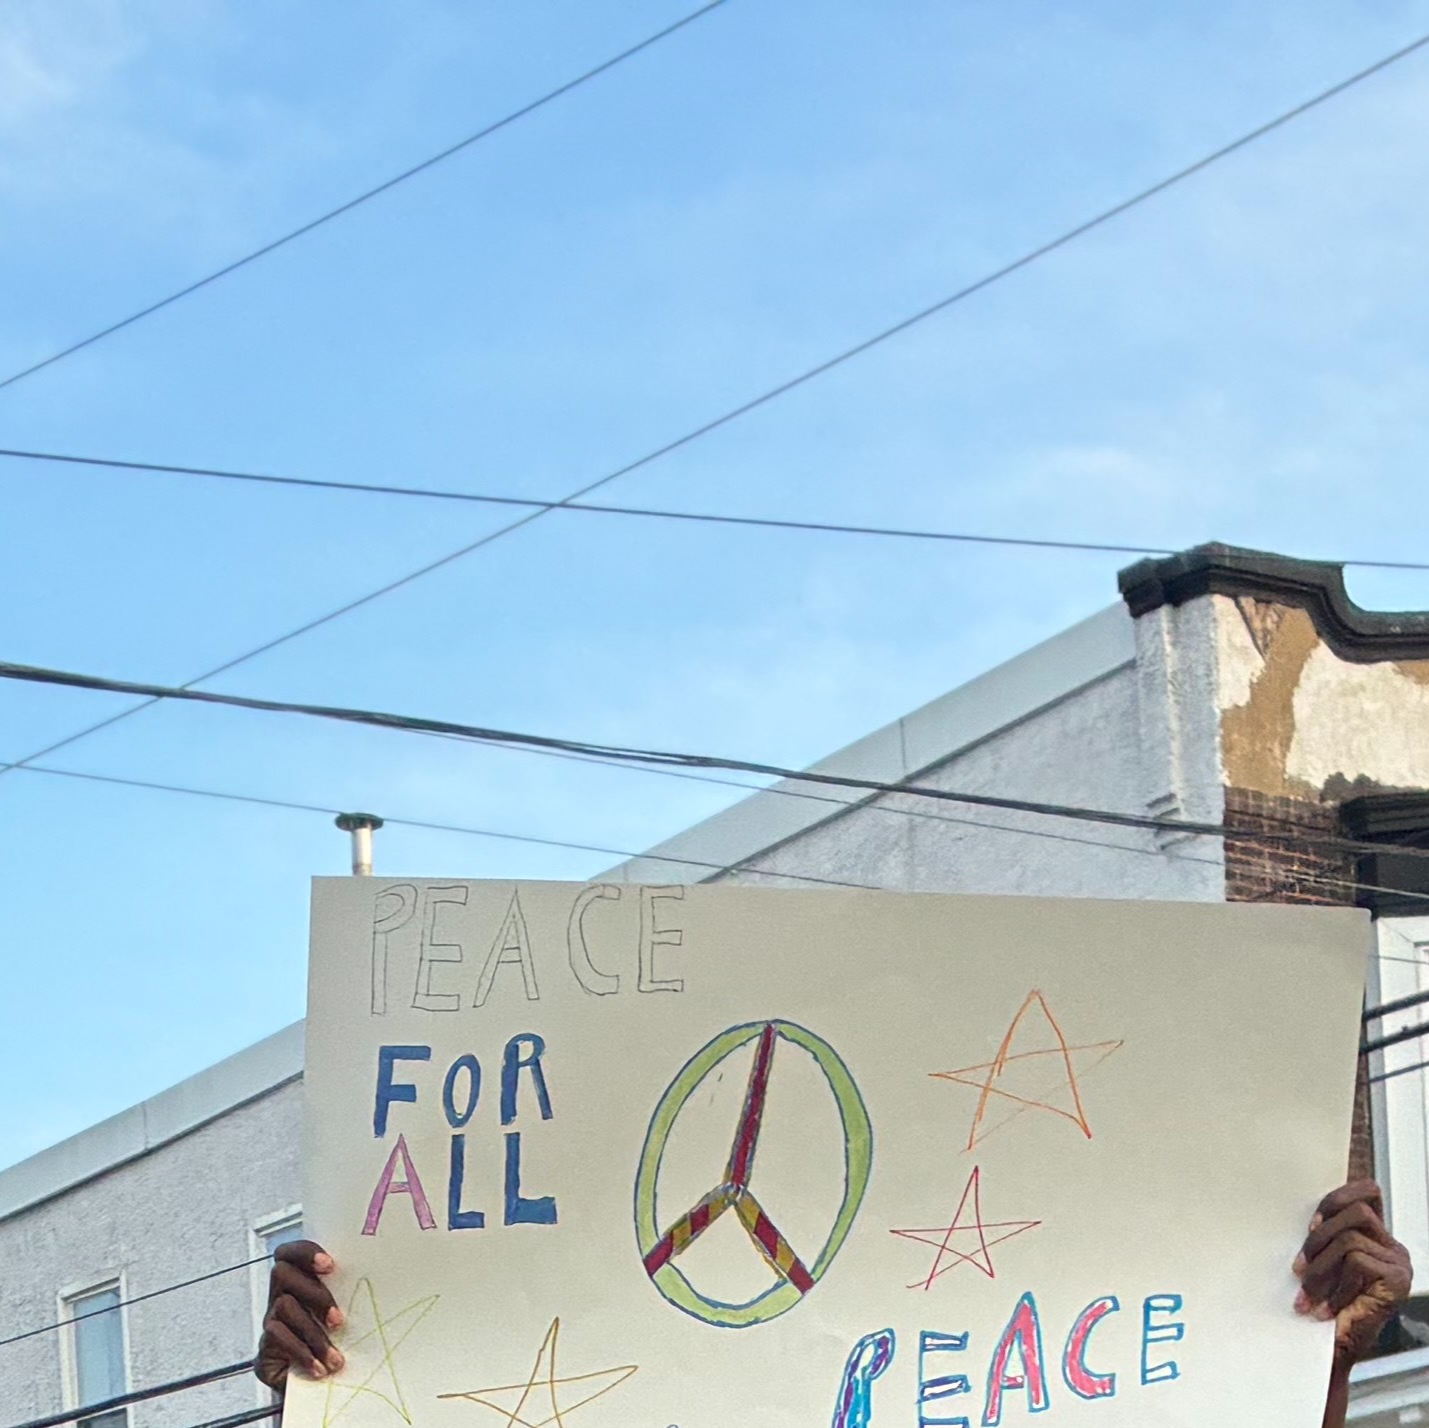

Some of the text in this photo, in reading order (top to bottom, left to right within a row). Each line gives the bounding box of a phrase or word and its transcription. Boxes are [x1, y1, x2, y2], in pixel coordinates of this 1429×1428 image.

[370, 883, 686, 1016] PEACE
[374, 1032, 554, 1139] FOR
[361, 1132, 558, 1236] ALL
